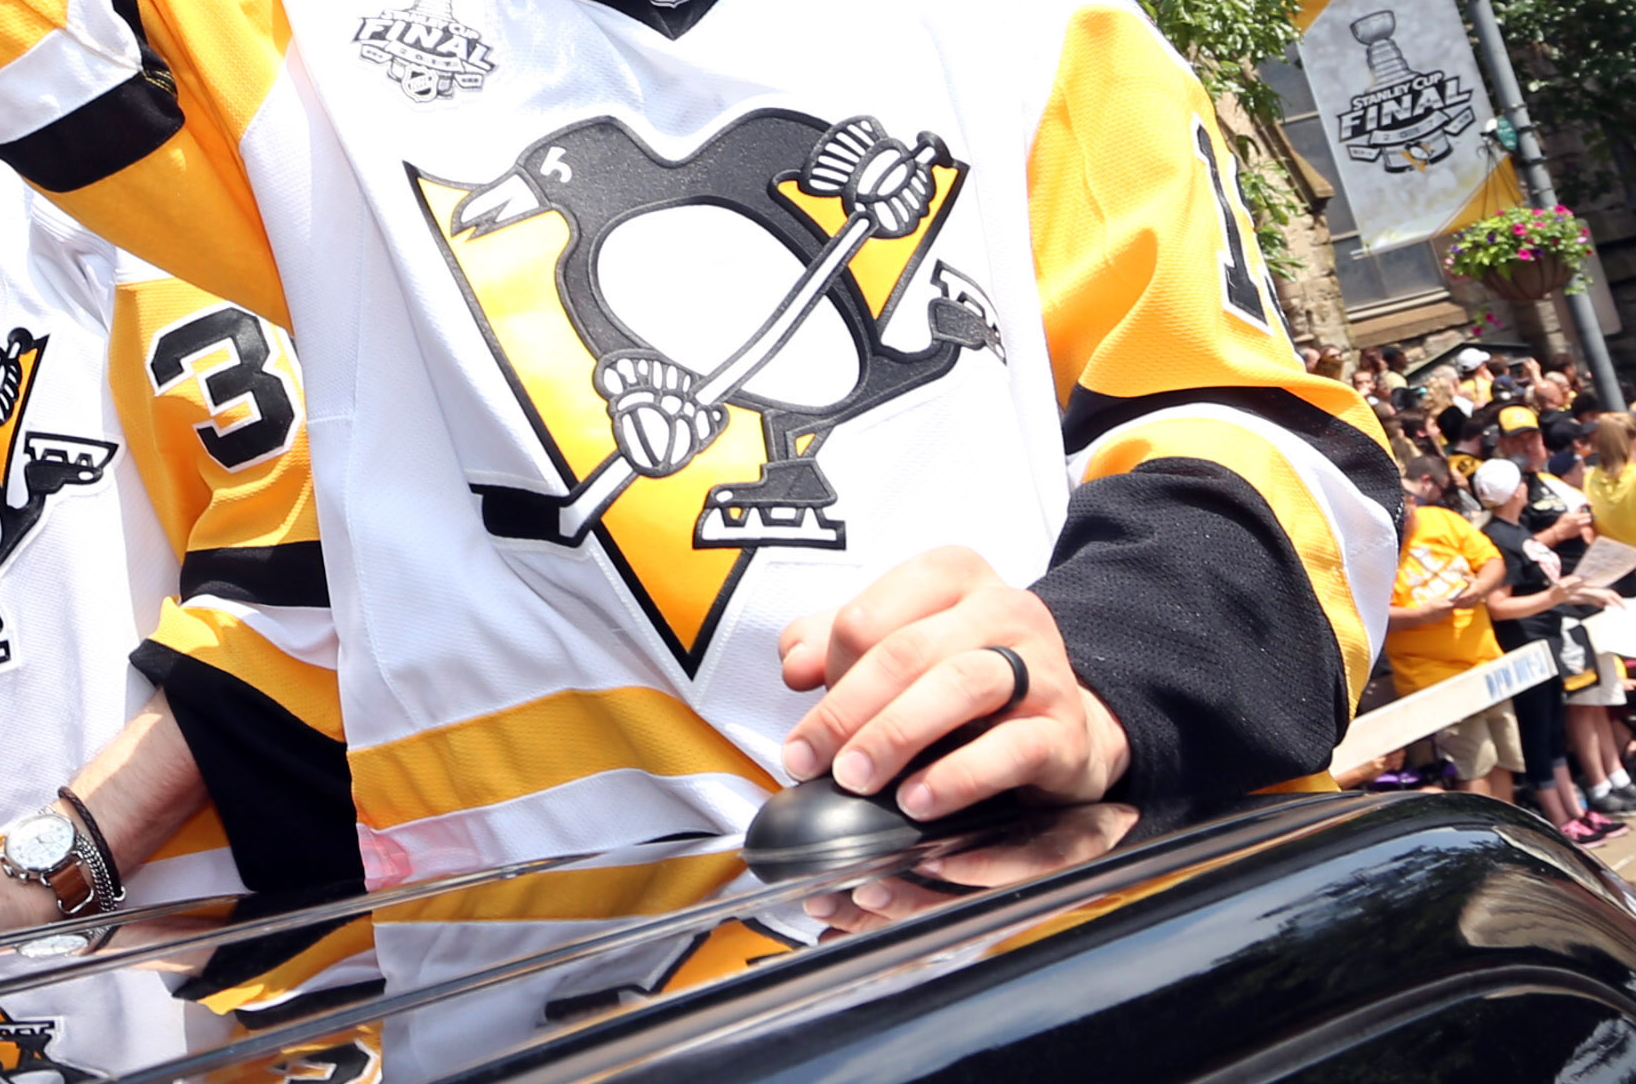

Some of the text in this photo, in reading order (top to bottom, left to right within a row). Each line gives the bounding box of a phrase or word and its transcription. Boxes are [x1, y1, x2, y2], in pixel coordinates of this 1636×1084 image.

[357, 17, 493, 72] FINAL
[1340, 77, 1472, 139] FINAL
[1352, 72, 1443, 111] STANLEY CUP
[146, 302, 304, 473] 3
